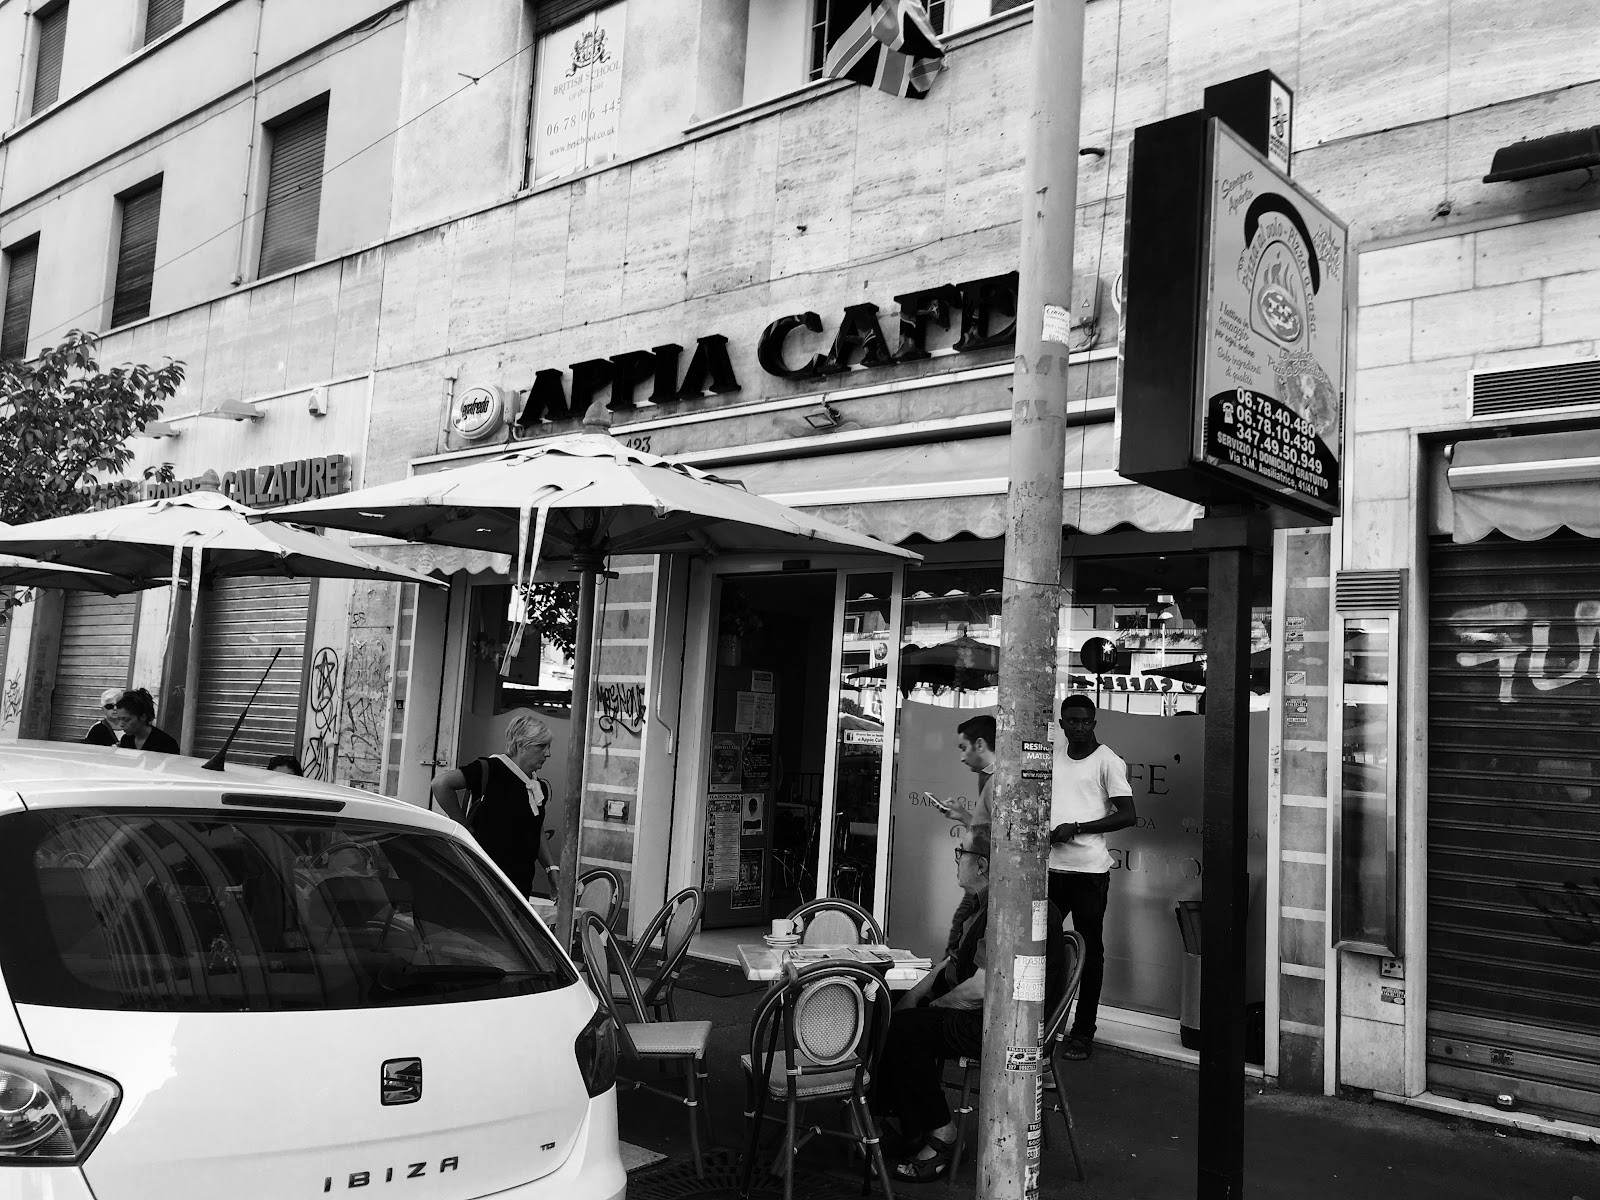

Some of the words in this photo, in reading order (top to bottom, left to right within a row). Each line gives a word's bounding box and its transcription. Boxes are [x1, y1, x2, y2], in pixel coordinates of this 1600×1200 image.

[553, 74, 584, 95] BRITISH
[585, 60, 621, 81] SCHOOL
[546, 122, 559, 137] 06
[564, 114, 576, 131] 78
[517, 334, 742, 427] APPIA
[757, 270, 1020, 380] CAFE
[1236, 386, 1316, 439] 06.78.40.480
[1236, 405, 1316, 455] 06.78.10.430
[1217, 431, 1252, 457] SERVIZIO
[1252, 447, 1258, 460] A
[1258, 450, 1295, 476] DOMICILIO
[1295, 466, 1329, 490] GRATUITO
[1228, 448, 1241, 464] Via
[1242, 455, 1257, 471] S.M.
[1258, 462, 1299, 490] Ausiliatrice,
[1298, 479, 1319, 497] 41/41A
[1236, 423, 1323, 475] 347.49.50.949
[221, 454, 347, 505] CALZATURE
[323, 1156, 459, 1193] IBIZA
